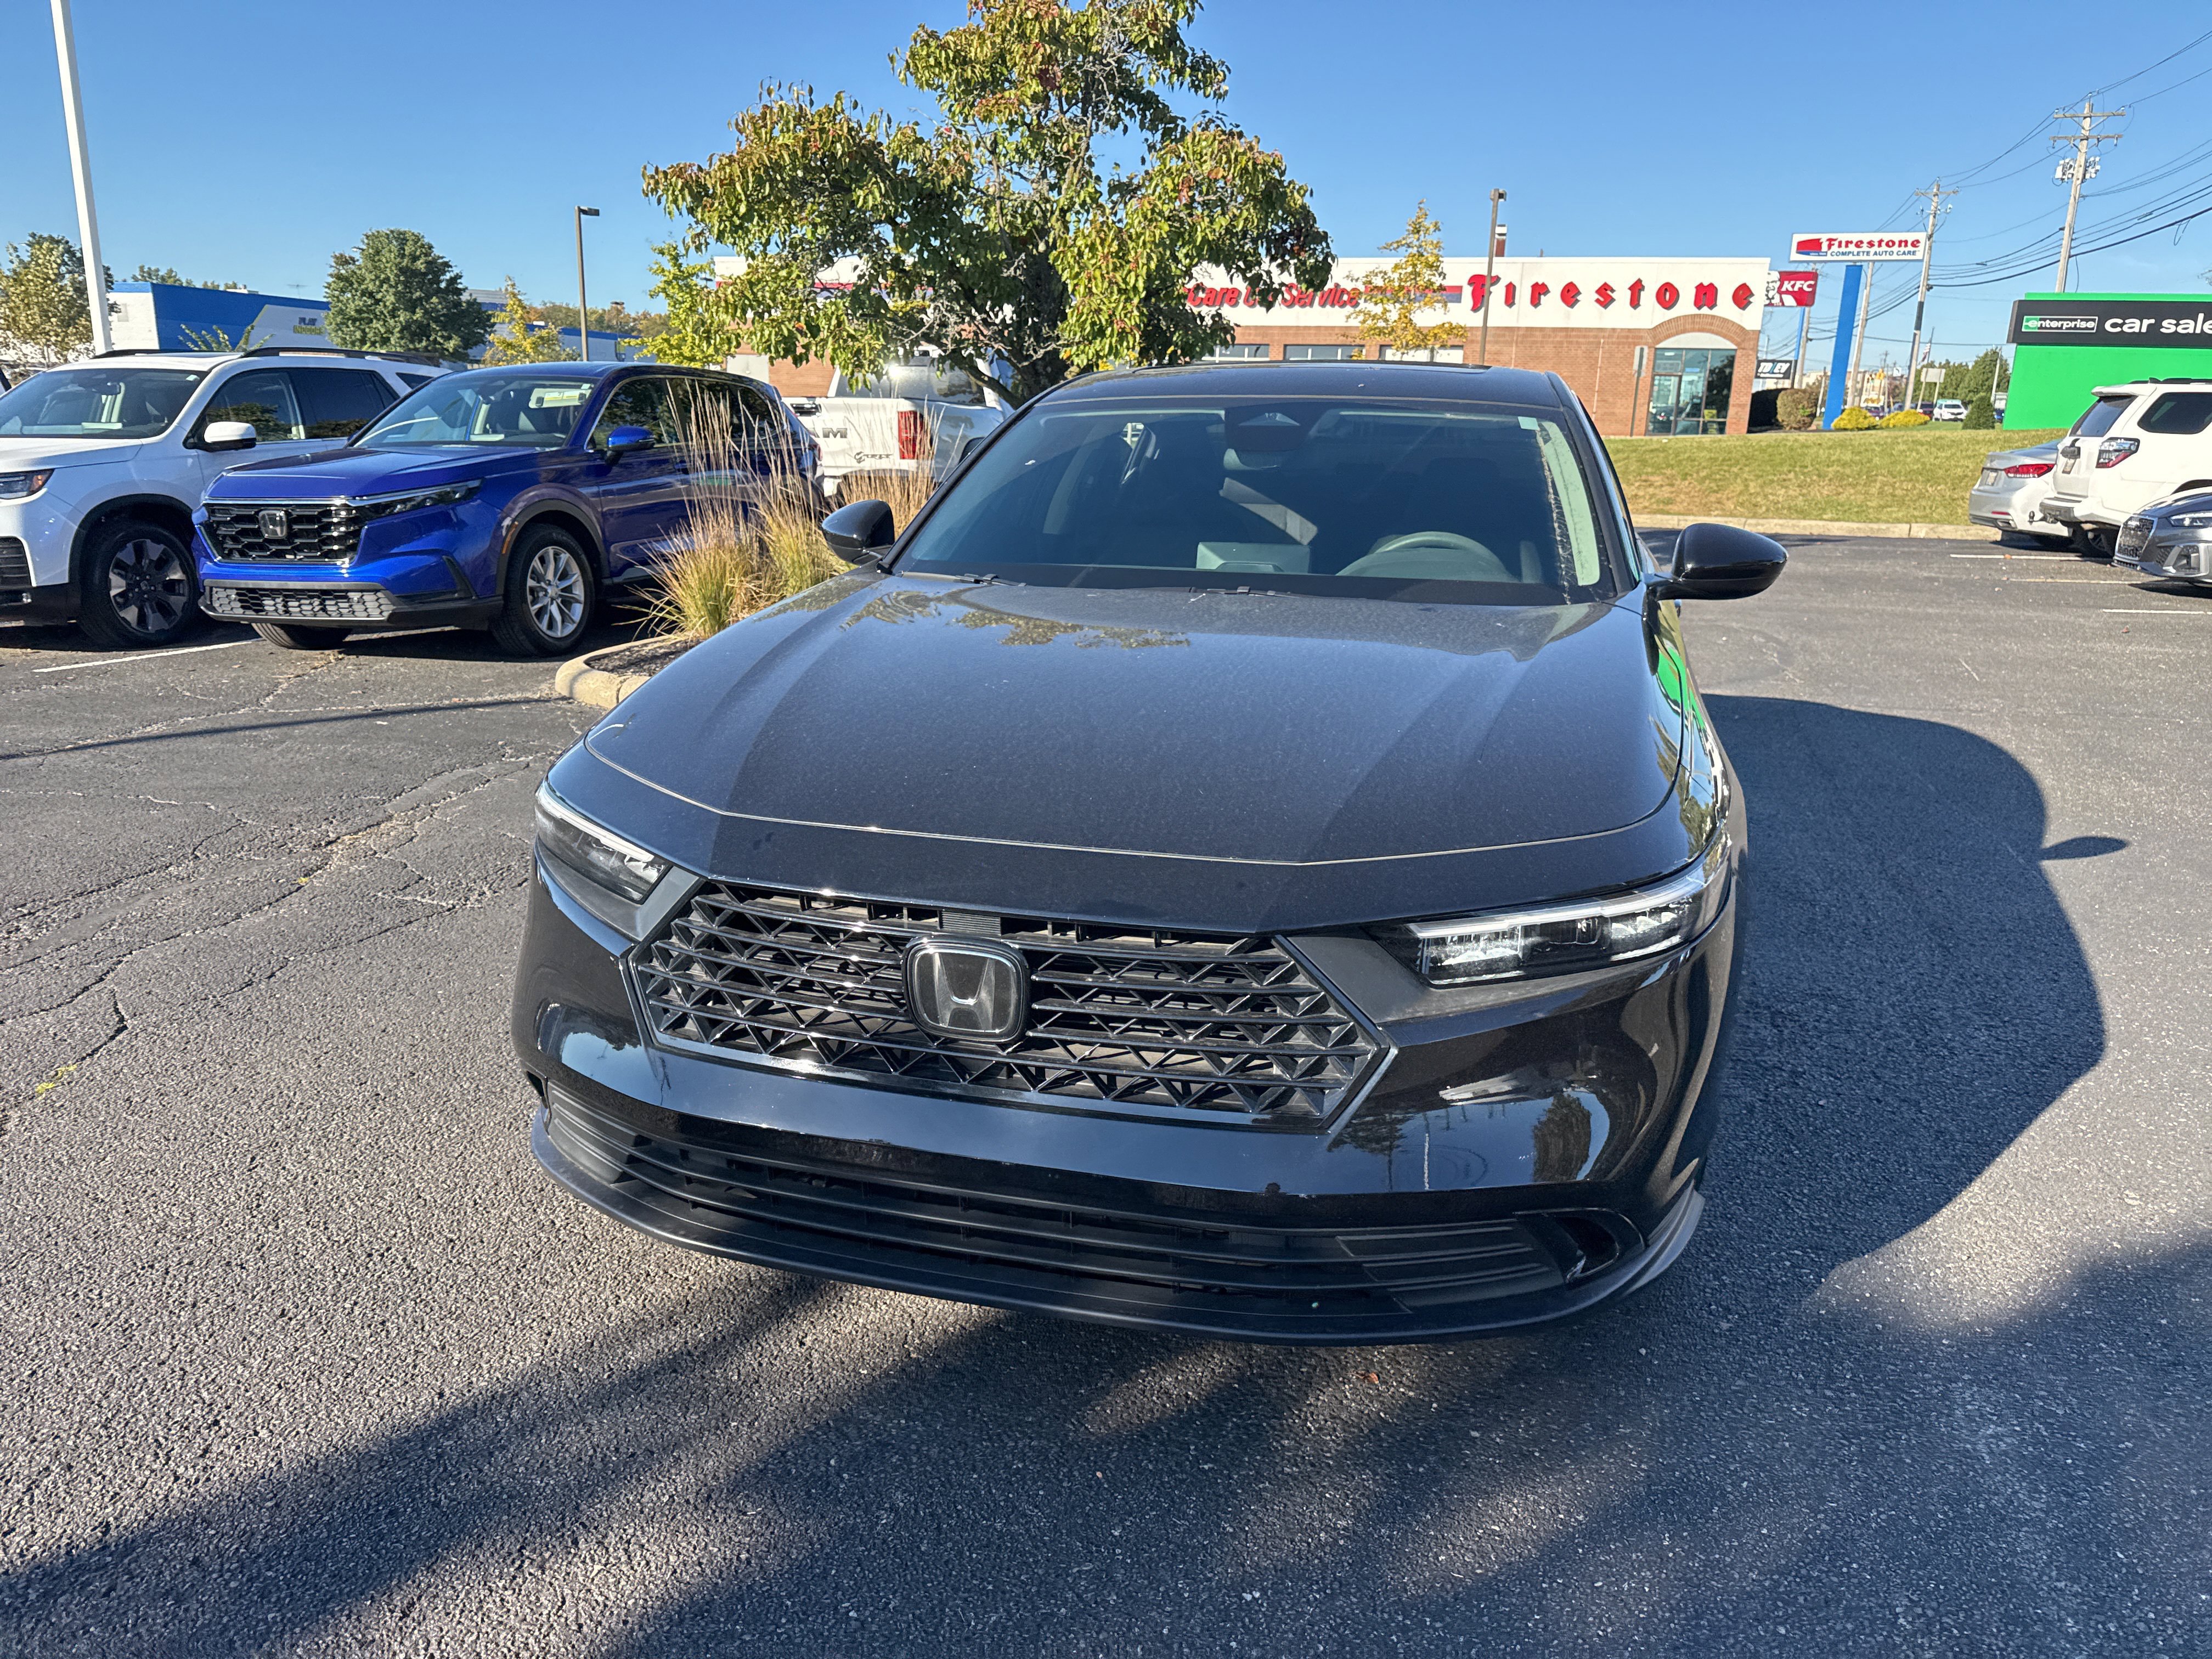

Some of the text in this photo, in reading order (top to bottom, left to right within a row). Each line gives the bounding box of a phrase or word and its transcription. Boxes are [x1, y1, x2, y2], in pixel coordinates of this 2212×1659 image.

[1826, 238, 1921, 251] Firestone
[1781, 280, 1815, 292] KFC
[1467, 274, 1755, 313] Firestone
[2025, 319, 2096, 330] enterprise
[2104, 318, 2155, 333] car
